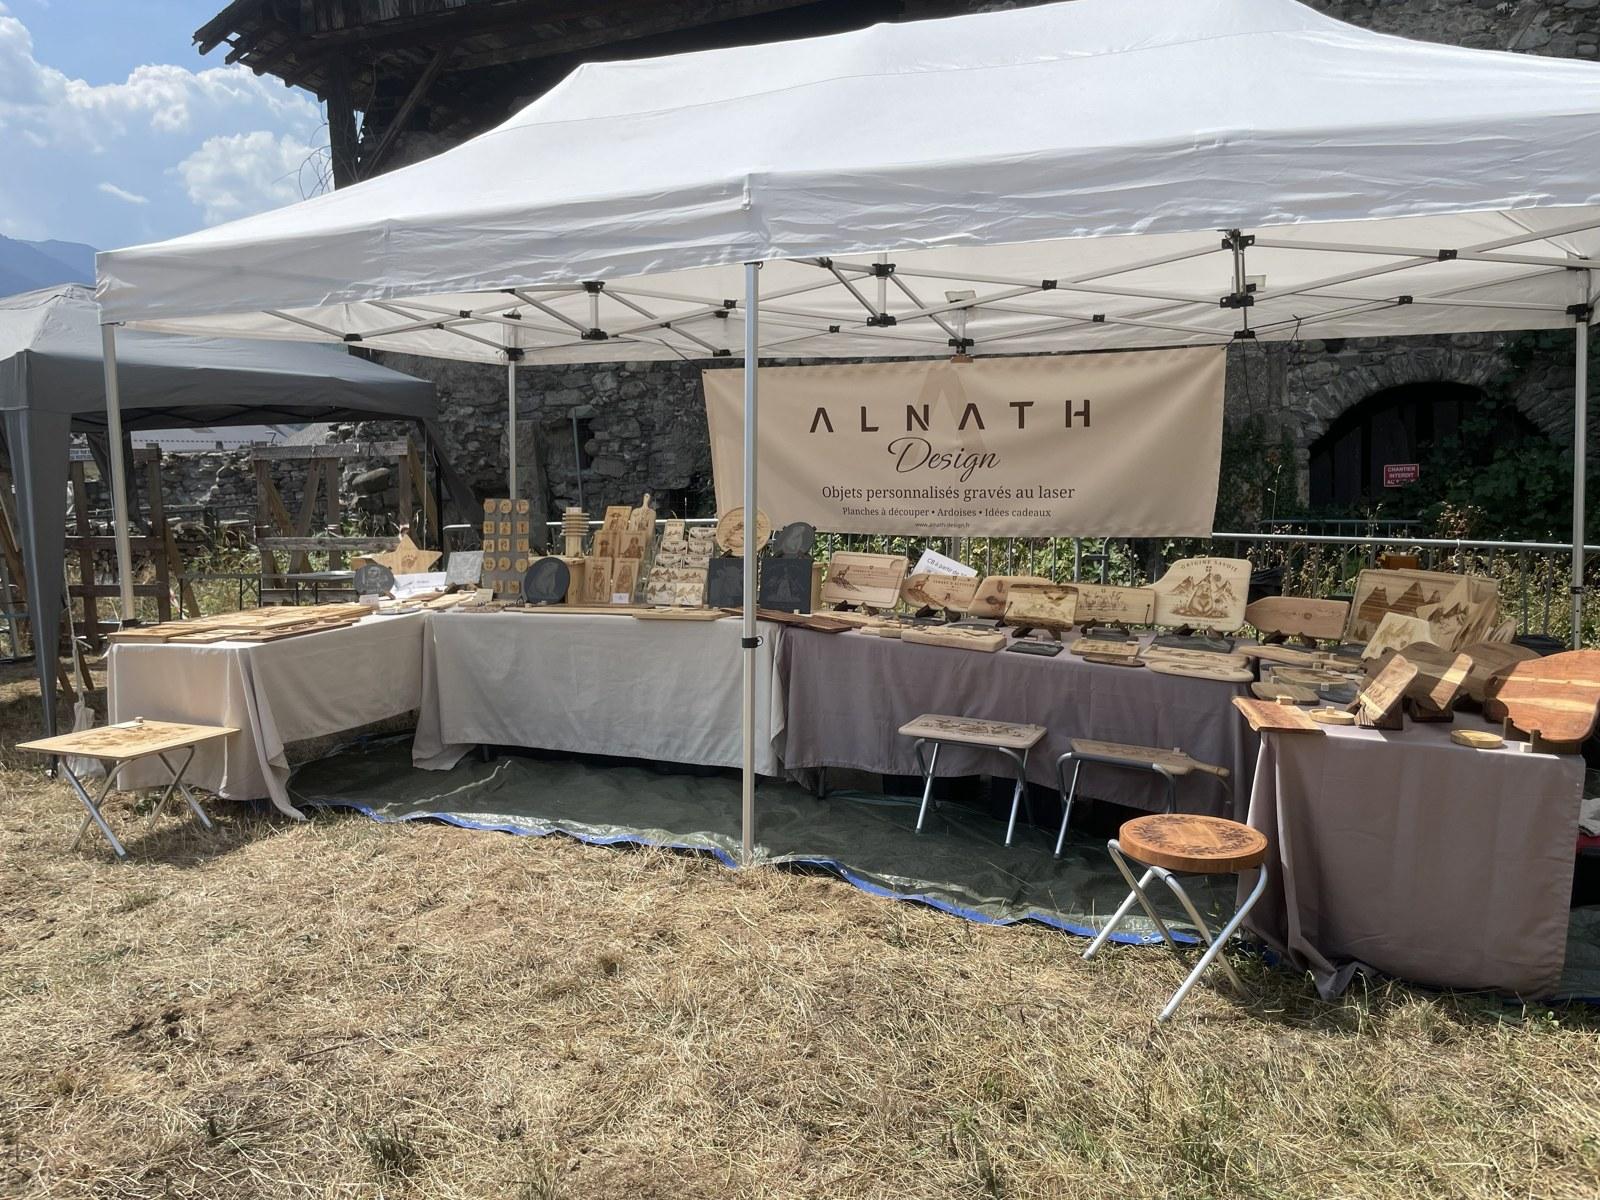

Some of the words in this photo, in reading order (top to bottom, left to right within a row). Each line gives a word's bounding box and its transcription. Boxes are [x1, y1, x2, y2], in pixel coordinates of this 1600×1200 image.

[809, 399, 1091, 433] ALNATH
[887, 436, 1000, 483] Design
[822, 486, 863, 502] Objets
[866, 486, 960, 502] personnalisés
[963, 486, 1012, 502] gravés
[1015, 488, 1034, 499] au
[1038, 485, 1076, 499] laser
[842, 507, 879, 516] Planches
[881, 507, 886, 516] à
[888, 507, 930, 518] découper
[937, 508, 977, 517] Ardoises
[984, 508, 1010, 517] Idées
[1011, 508, 1052, 517] cadeaux
